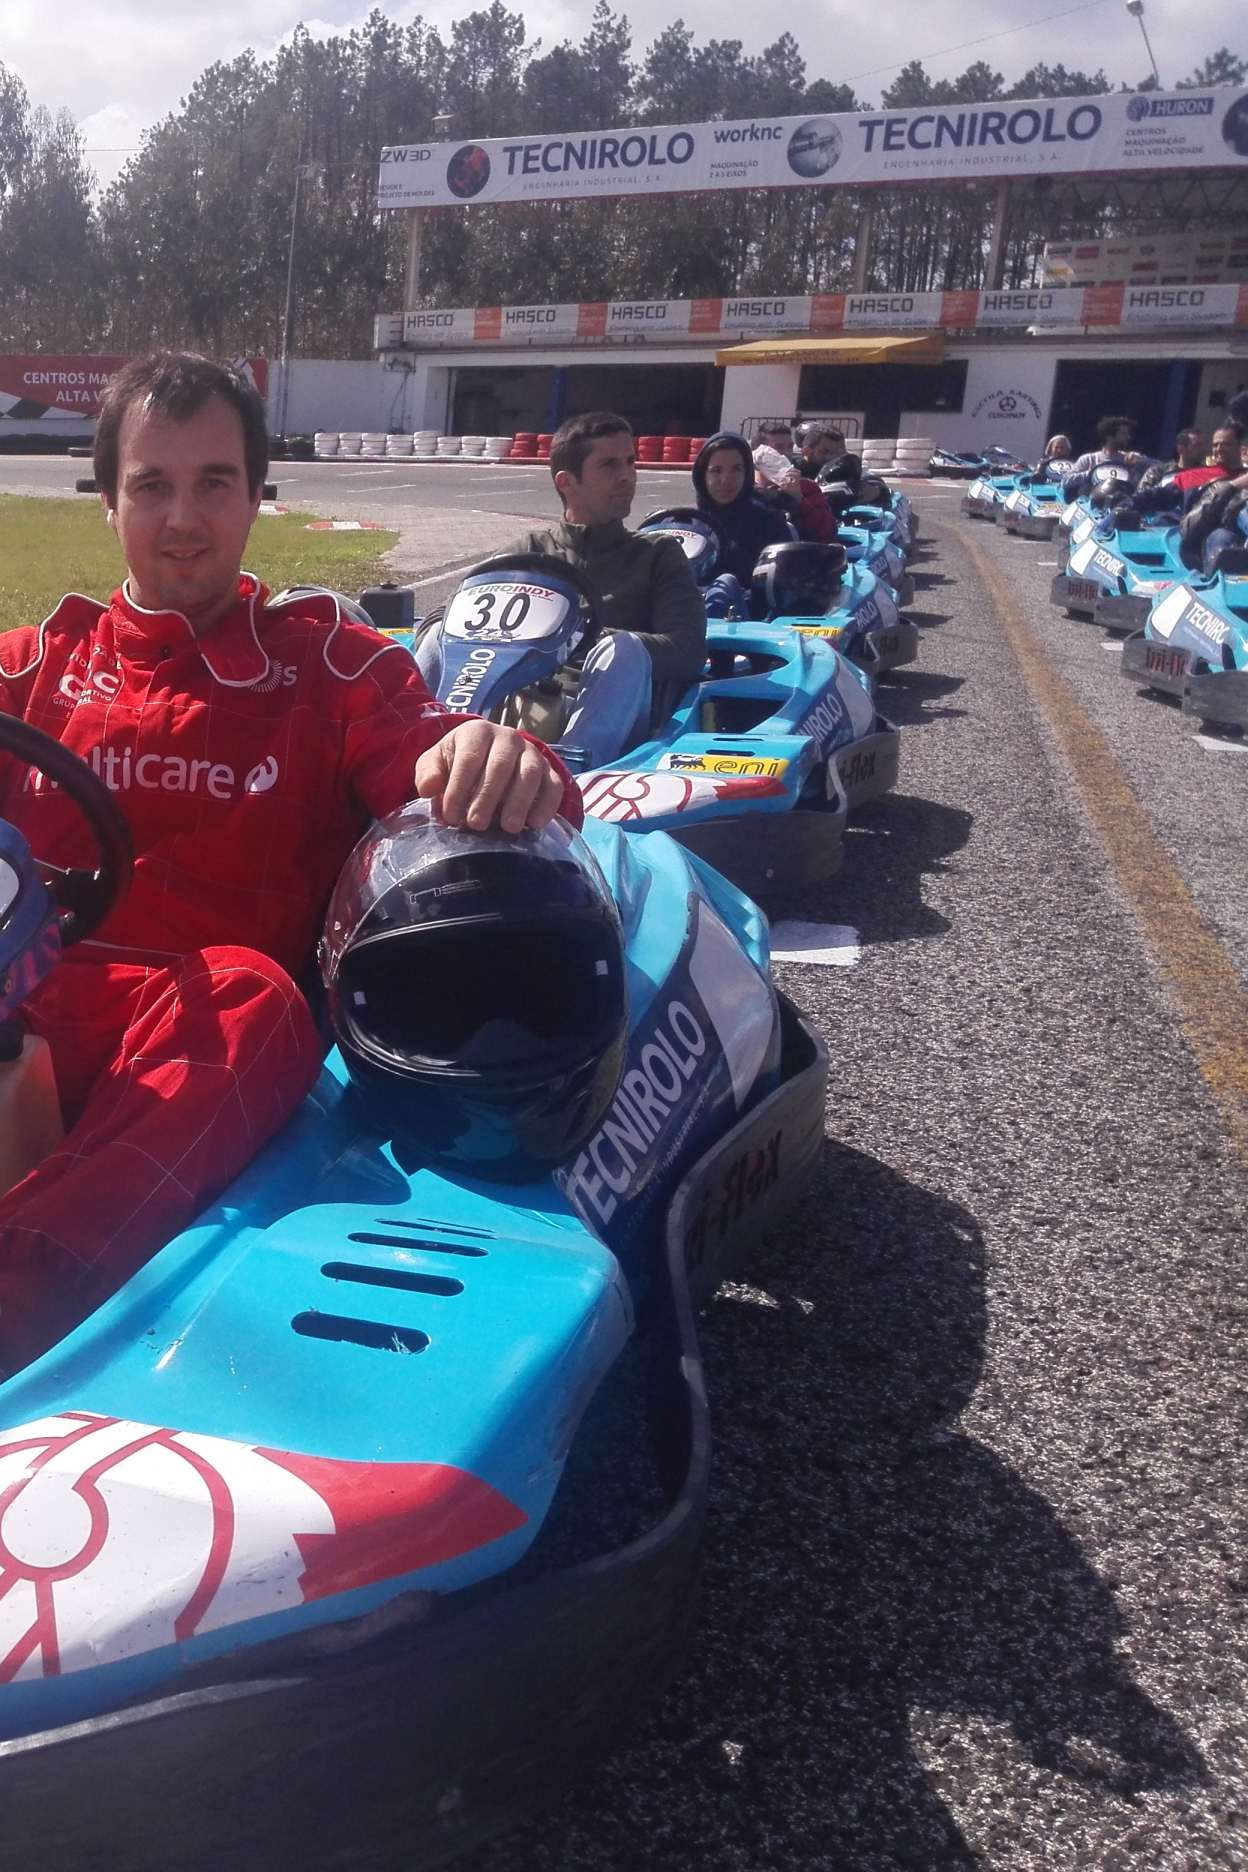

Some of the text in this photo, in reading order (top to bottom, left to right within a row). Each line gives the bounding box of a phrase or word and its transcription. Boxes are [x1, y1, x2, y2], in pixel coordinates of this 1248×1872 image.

[1155, 99, 1209, 115] HURON
[713, 122, 783, 144] worknc
[858, 104, 1102, 153] TECNIROLO
[502, 131, 695, 176] TECNIROLO
[850, 297, 914, 314] HASCO
[983, 294, 1053, 311] HASCO
[1129, 290, 1206, 308] HASCO
[505, 309, 556, 325] HASCO
[611, 305, 667, 320] HASCO
[726, 301, 786, 317] HASCO
[407, 313, 454, 329] HASCO
[23, 371, 86, 385] CENTROS
[55, 390, 91, 403] ALTA
[467, 585, 555, 598] EUROINDY
[464, 592, 532, 632] 30
[22, 745, 235, 799] mlticare
